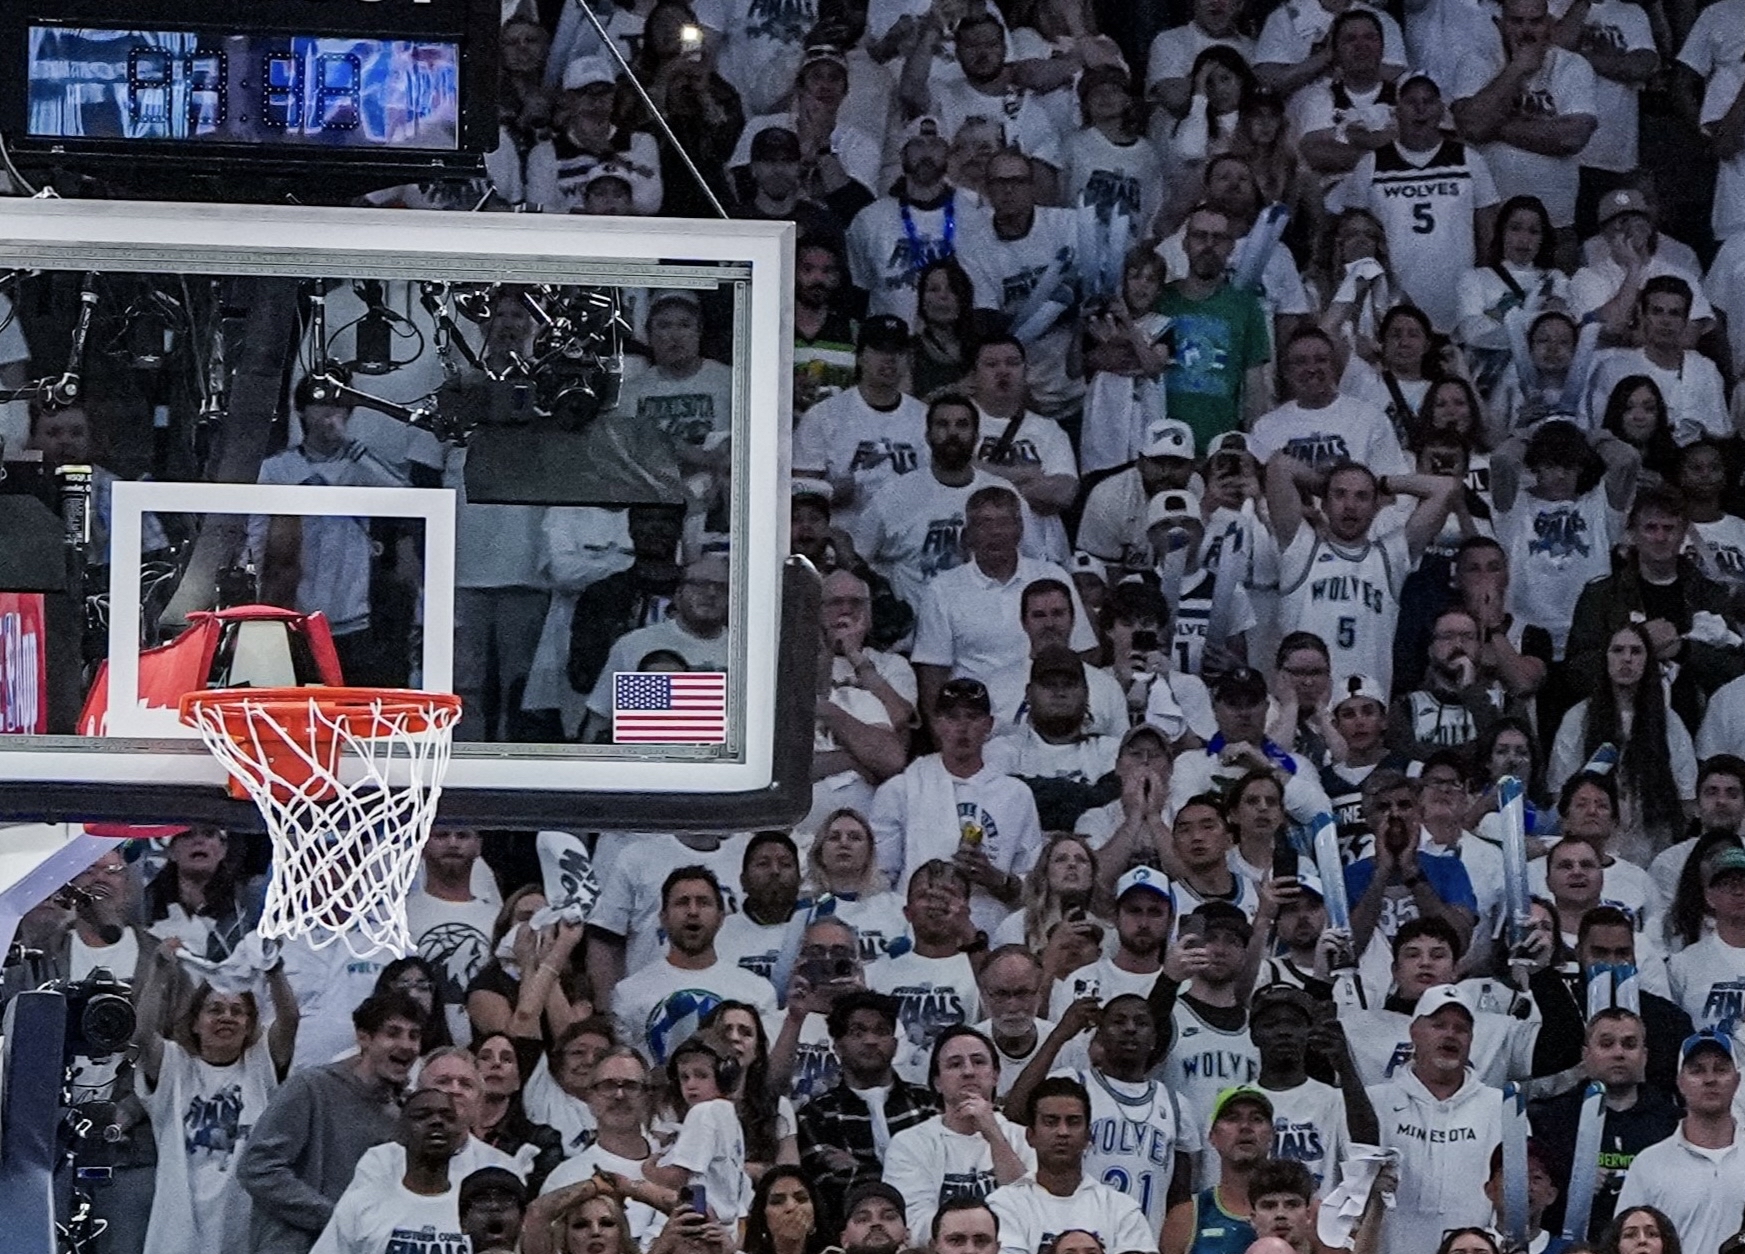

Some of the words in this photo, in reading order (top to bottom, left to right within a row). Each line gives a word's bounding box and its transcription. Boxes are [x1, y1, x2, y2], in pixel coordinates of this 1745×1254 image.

[1383, 183, 1460, 199] WOLVES
[1413, 202, 1435, 235] 5
[1312, 577, 1383, 615] WOLVES
[1338, 616, 1358, 649] 5
